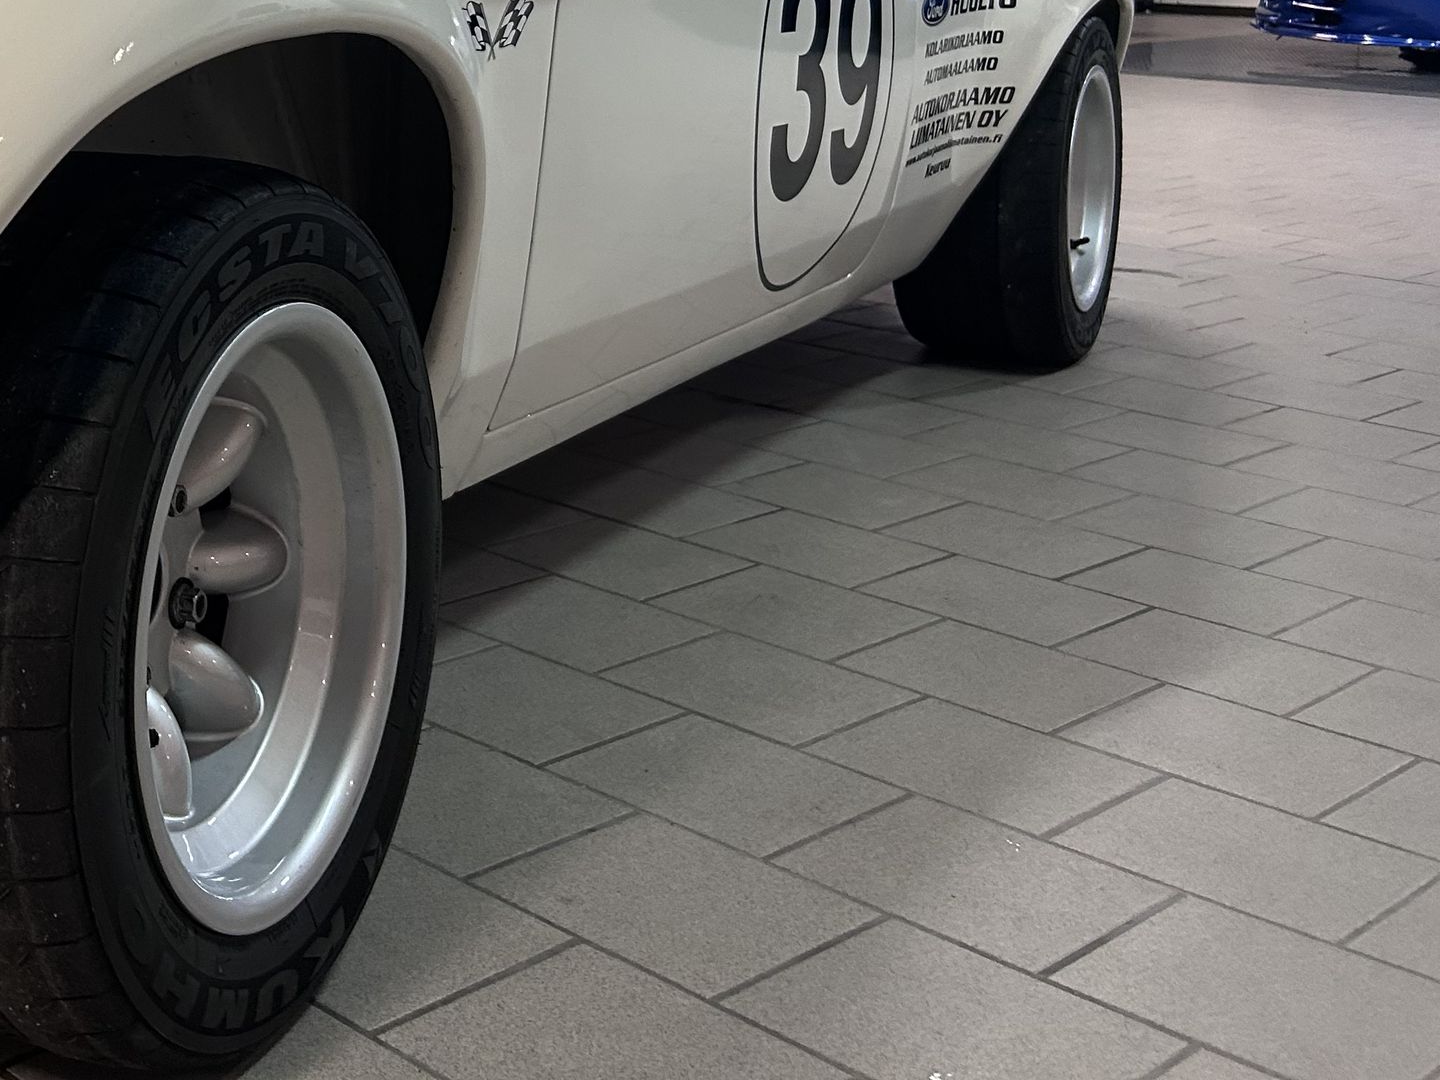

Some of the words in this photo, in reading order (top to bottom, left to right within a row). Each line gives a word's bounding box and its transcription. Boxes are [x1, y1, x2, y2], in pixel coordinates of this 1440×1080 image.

[924, 29, 1005, 59] KOLARIKORJAAMO
[923, 56, 999, 86] AUTOMAALAAMO
[911, 86, 1016, 126] AUTOKORJAAMO
[909, 110, 977, 150] LIIMATAINEN
[977, 109, 1009, 128] OY
[143, 220, 324, 443] ECSTA
[116, 900, 347, 1030] KUMHO
